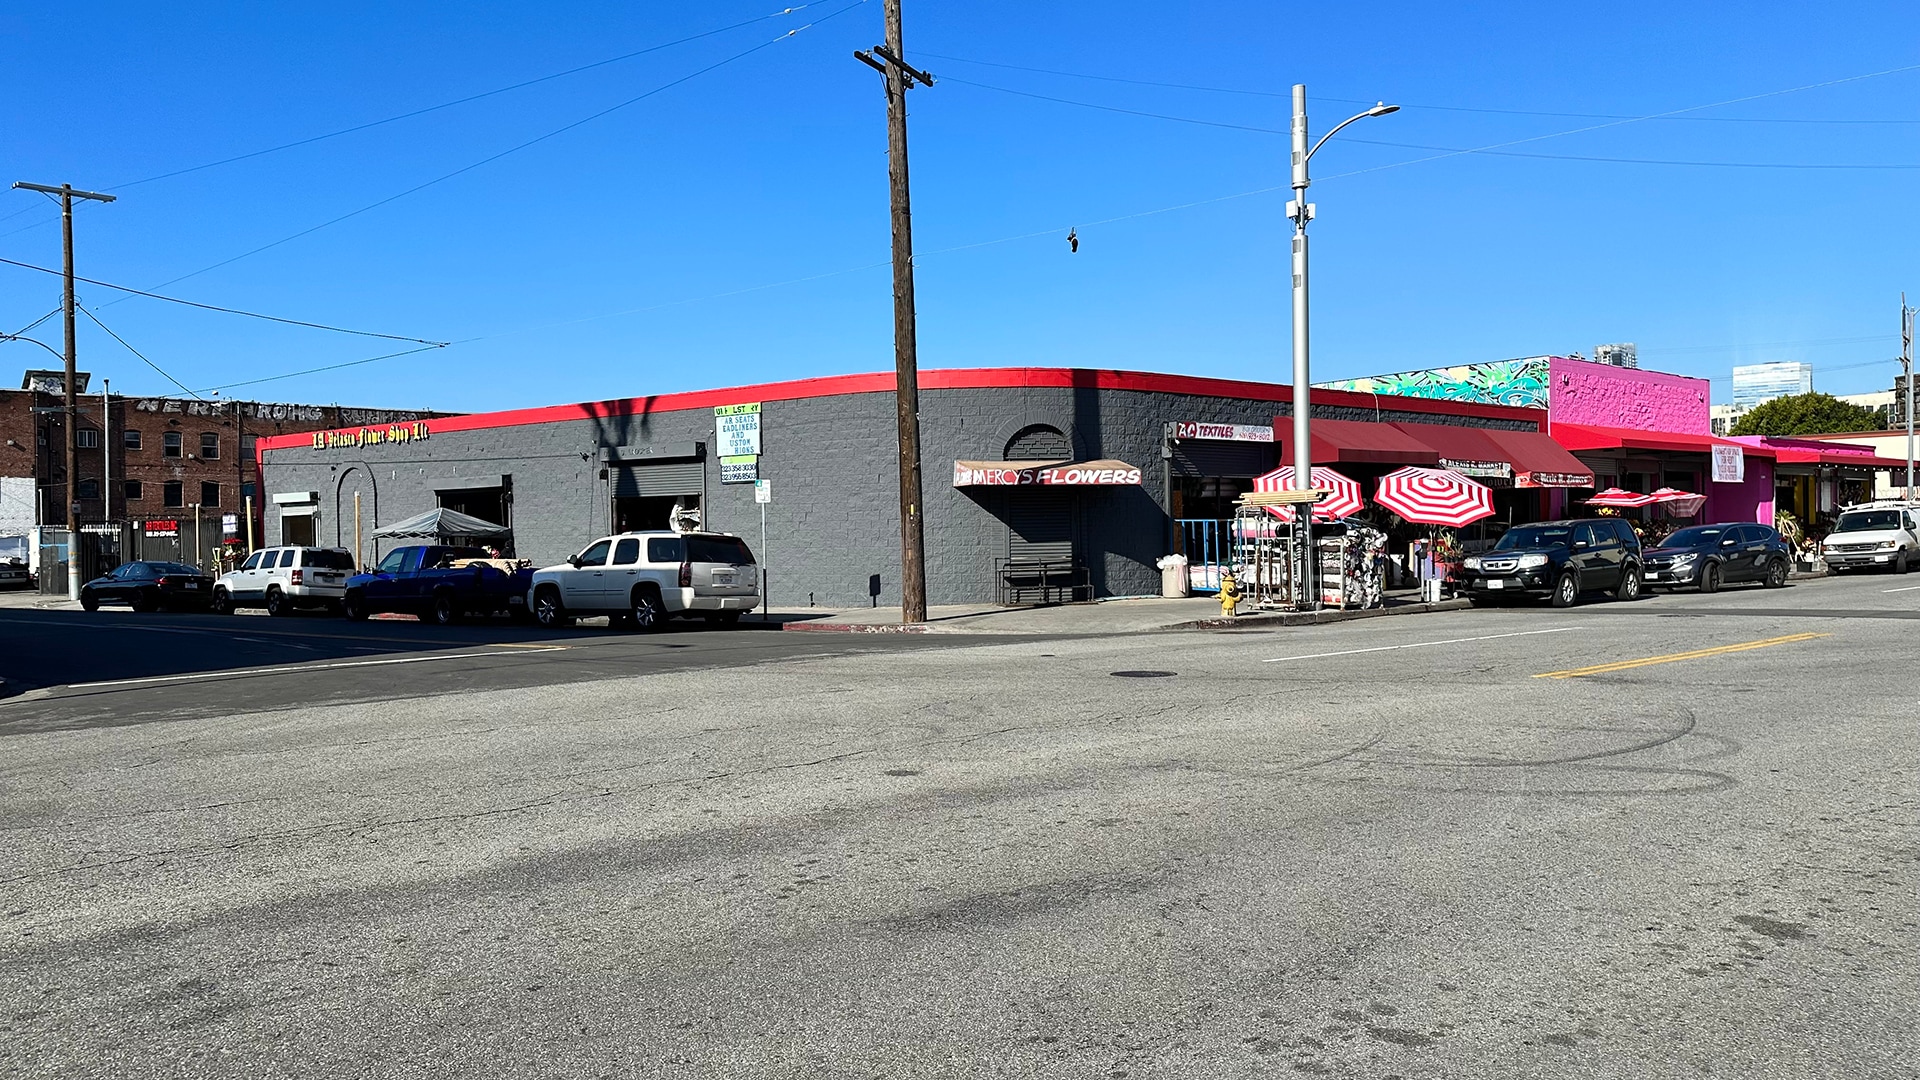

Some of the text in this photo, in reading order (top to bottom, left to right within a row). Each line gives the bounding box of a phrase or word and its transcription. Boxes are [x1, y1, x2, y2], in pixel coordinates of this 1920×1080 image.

[735, 415, 755, 424] SEATS
[721, 423, 758, 432] EADLINERS
[1199, 425, 1234, 439] TEXTILES
[731, 431, 745, 439] AND
[728, 439, 751, 447] USTOM
[1036, 469, 1141, 484] FLOWERS
